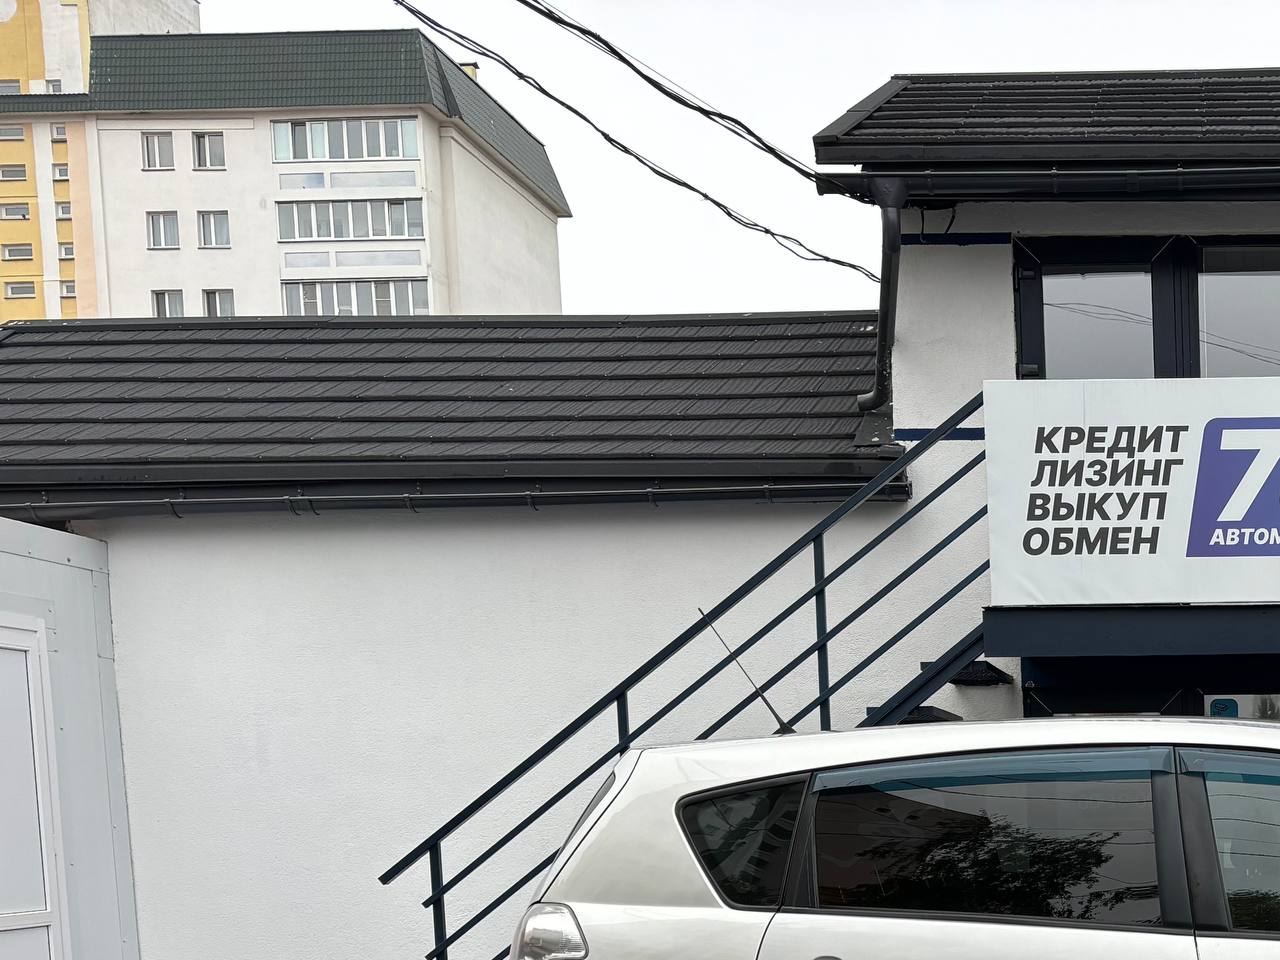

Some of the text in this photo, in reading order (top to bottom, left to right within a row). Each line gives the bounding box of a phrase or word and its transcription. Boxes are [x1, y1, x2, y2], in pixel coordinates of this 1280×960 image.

[1034, 425, 1189, 459] КРЕДИТ
[1030, 459, 1184, 487] ЛИЗИНГ
[1026, 492, 1168, 521] ВЫКУП
[1022, 526, 1160, 556] ОБМЕН
